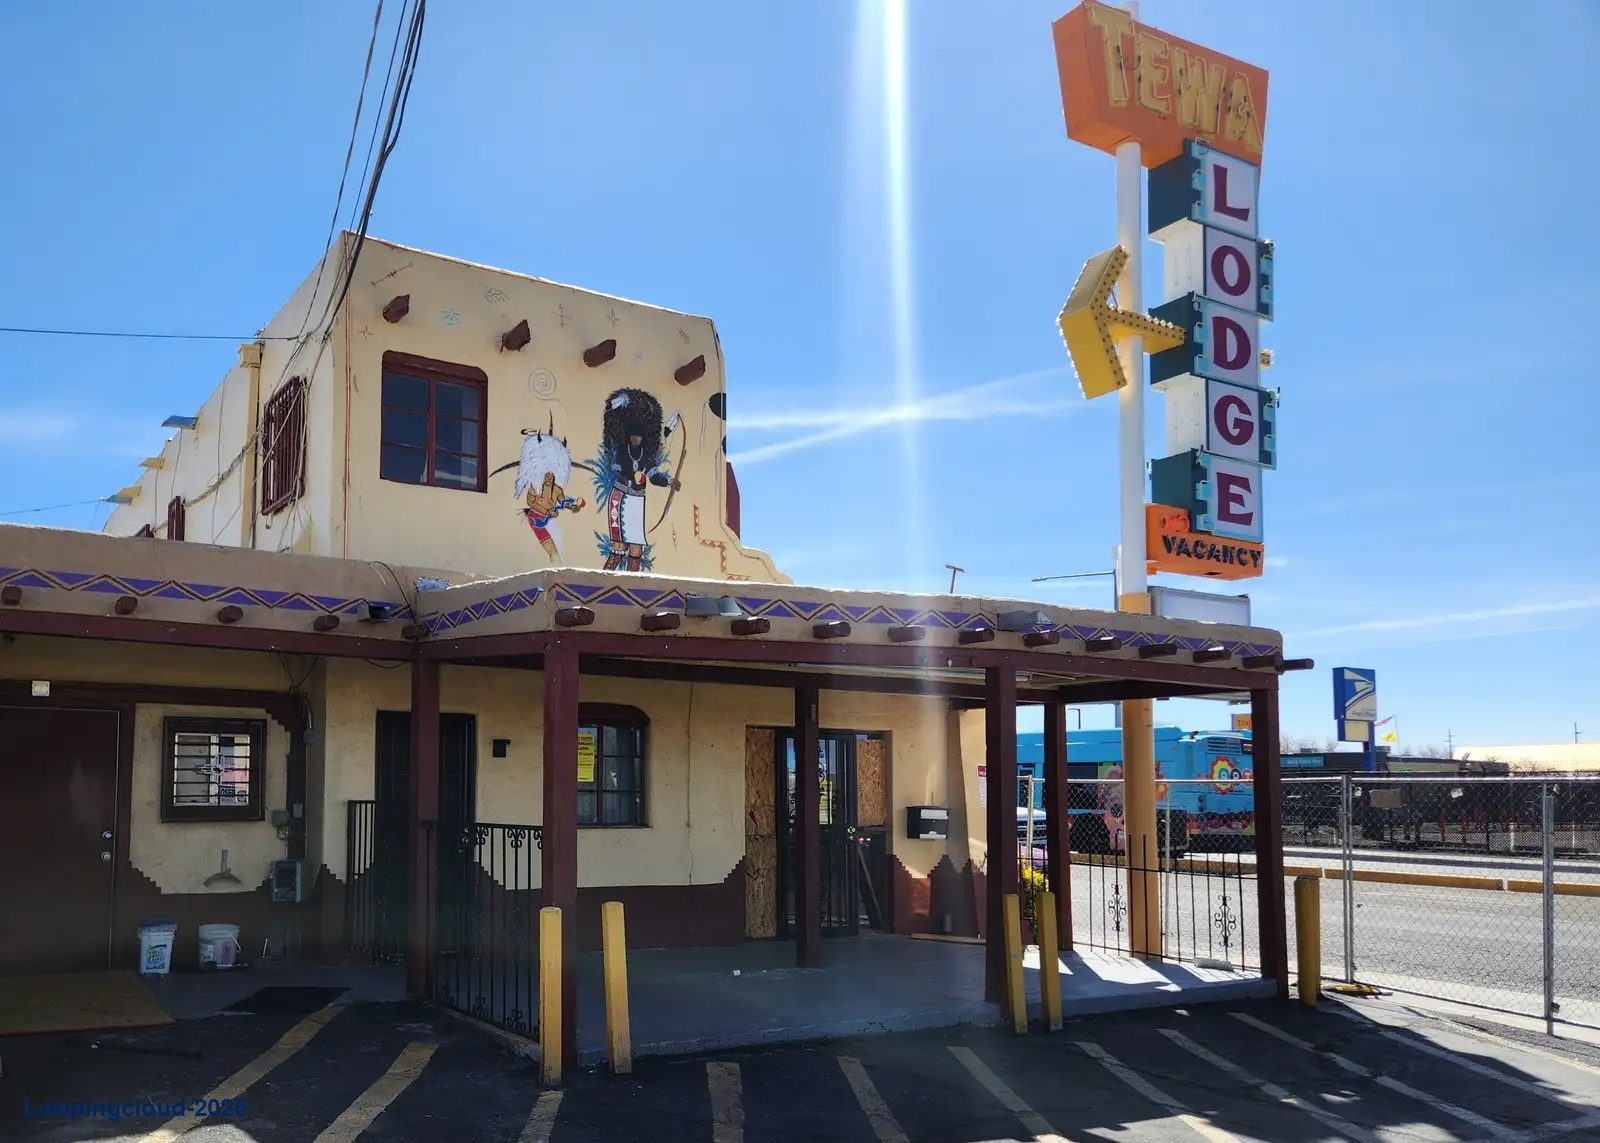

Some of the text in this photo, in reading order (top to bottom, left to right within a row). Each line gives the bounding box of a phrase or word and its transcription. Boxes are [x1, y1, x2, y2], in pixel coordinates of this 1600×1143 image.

[1085, 3, 1263, 152] TEWA
[1211, 164, 1254, 526] LODGE
[1162, 534, 1262, 568] VACANCY
